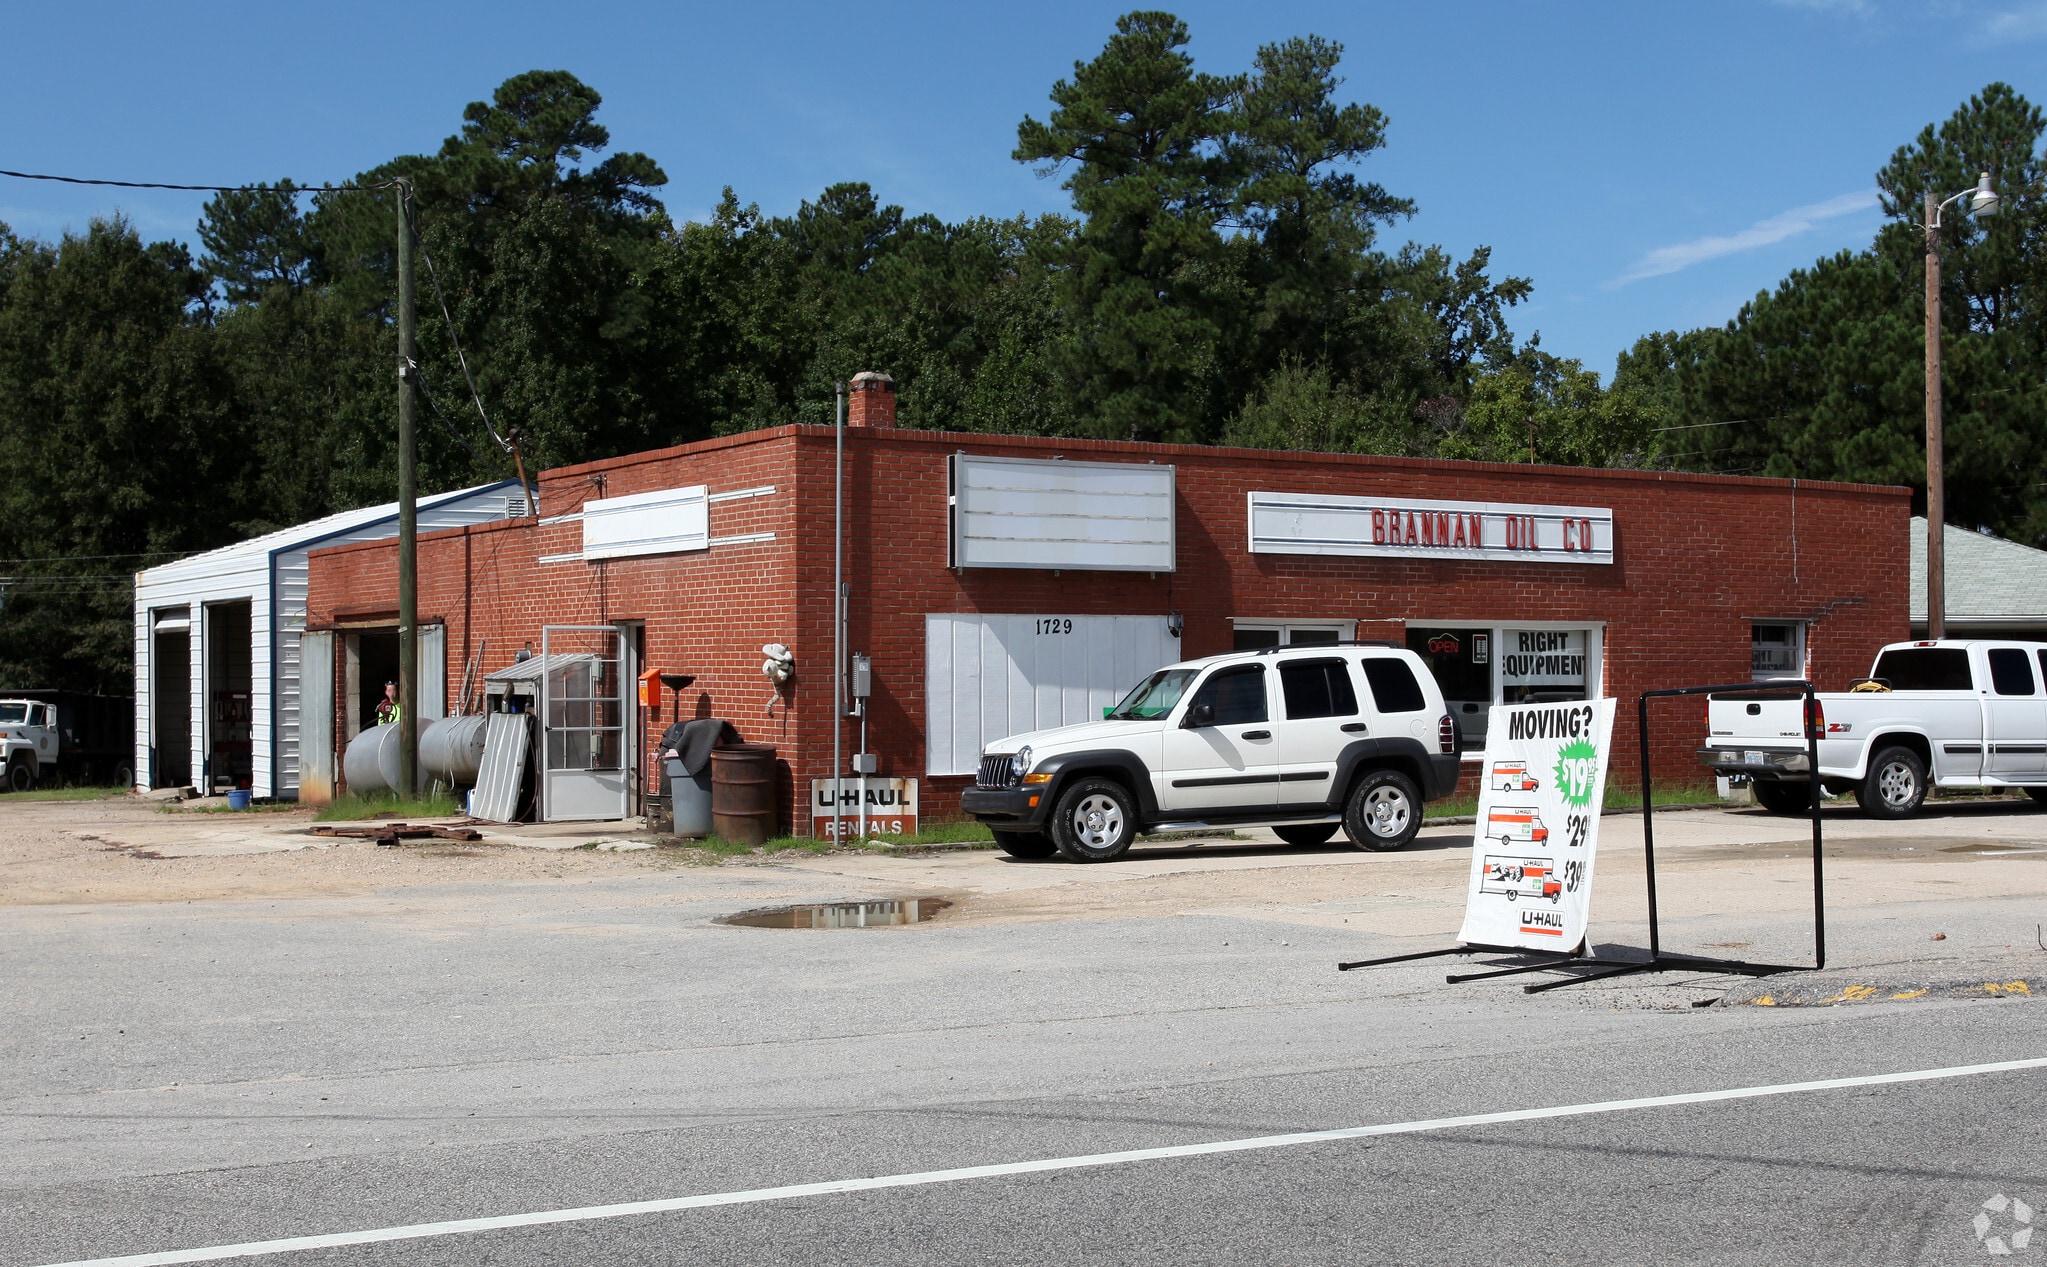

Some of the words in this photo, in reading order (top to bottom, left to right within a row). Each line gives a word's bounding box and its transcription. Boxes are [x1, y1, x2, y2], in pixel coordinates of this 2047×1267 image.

[1371, 508, 1482, 549] BRANNAN
[1505, 514, 1538, 551] OIL
[1563, 517, 1591, 552] CO
[1036, 618, 1072, 635] 1729
[1428, 640, 1459, 653] OPEN
[1518, 632, 1568, 652] RIGHT
[1508, 705, 1593, 740] MOVING?
[1827, 723, 1853, 733] Z71
[1566, 812, 1588, 847] $29
[1564, 858, 1583, 893] $39
[1521, 911, 1563, 928] U-HAUL
